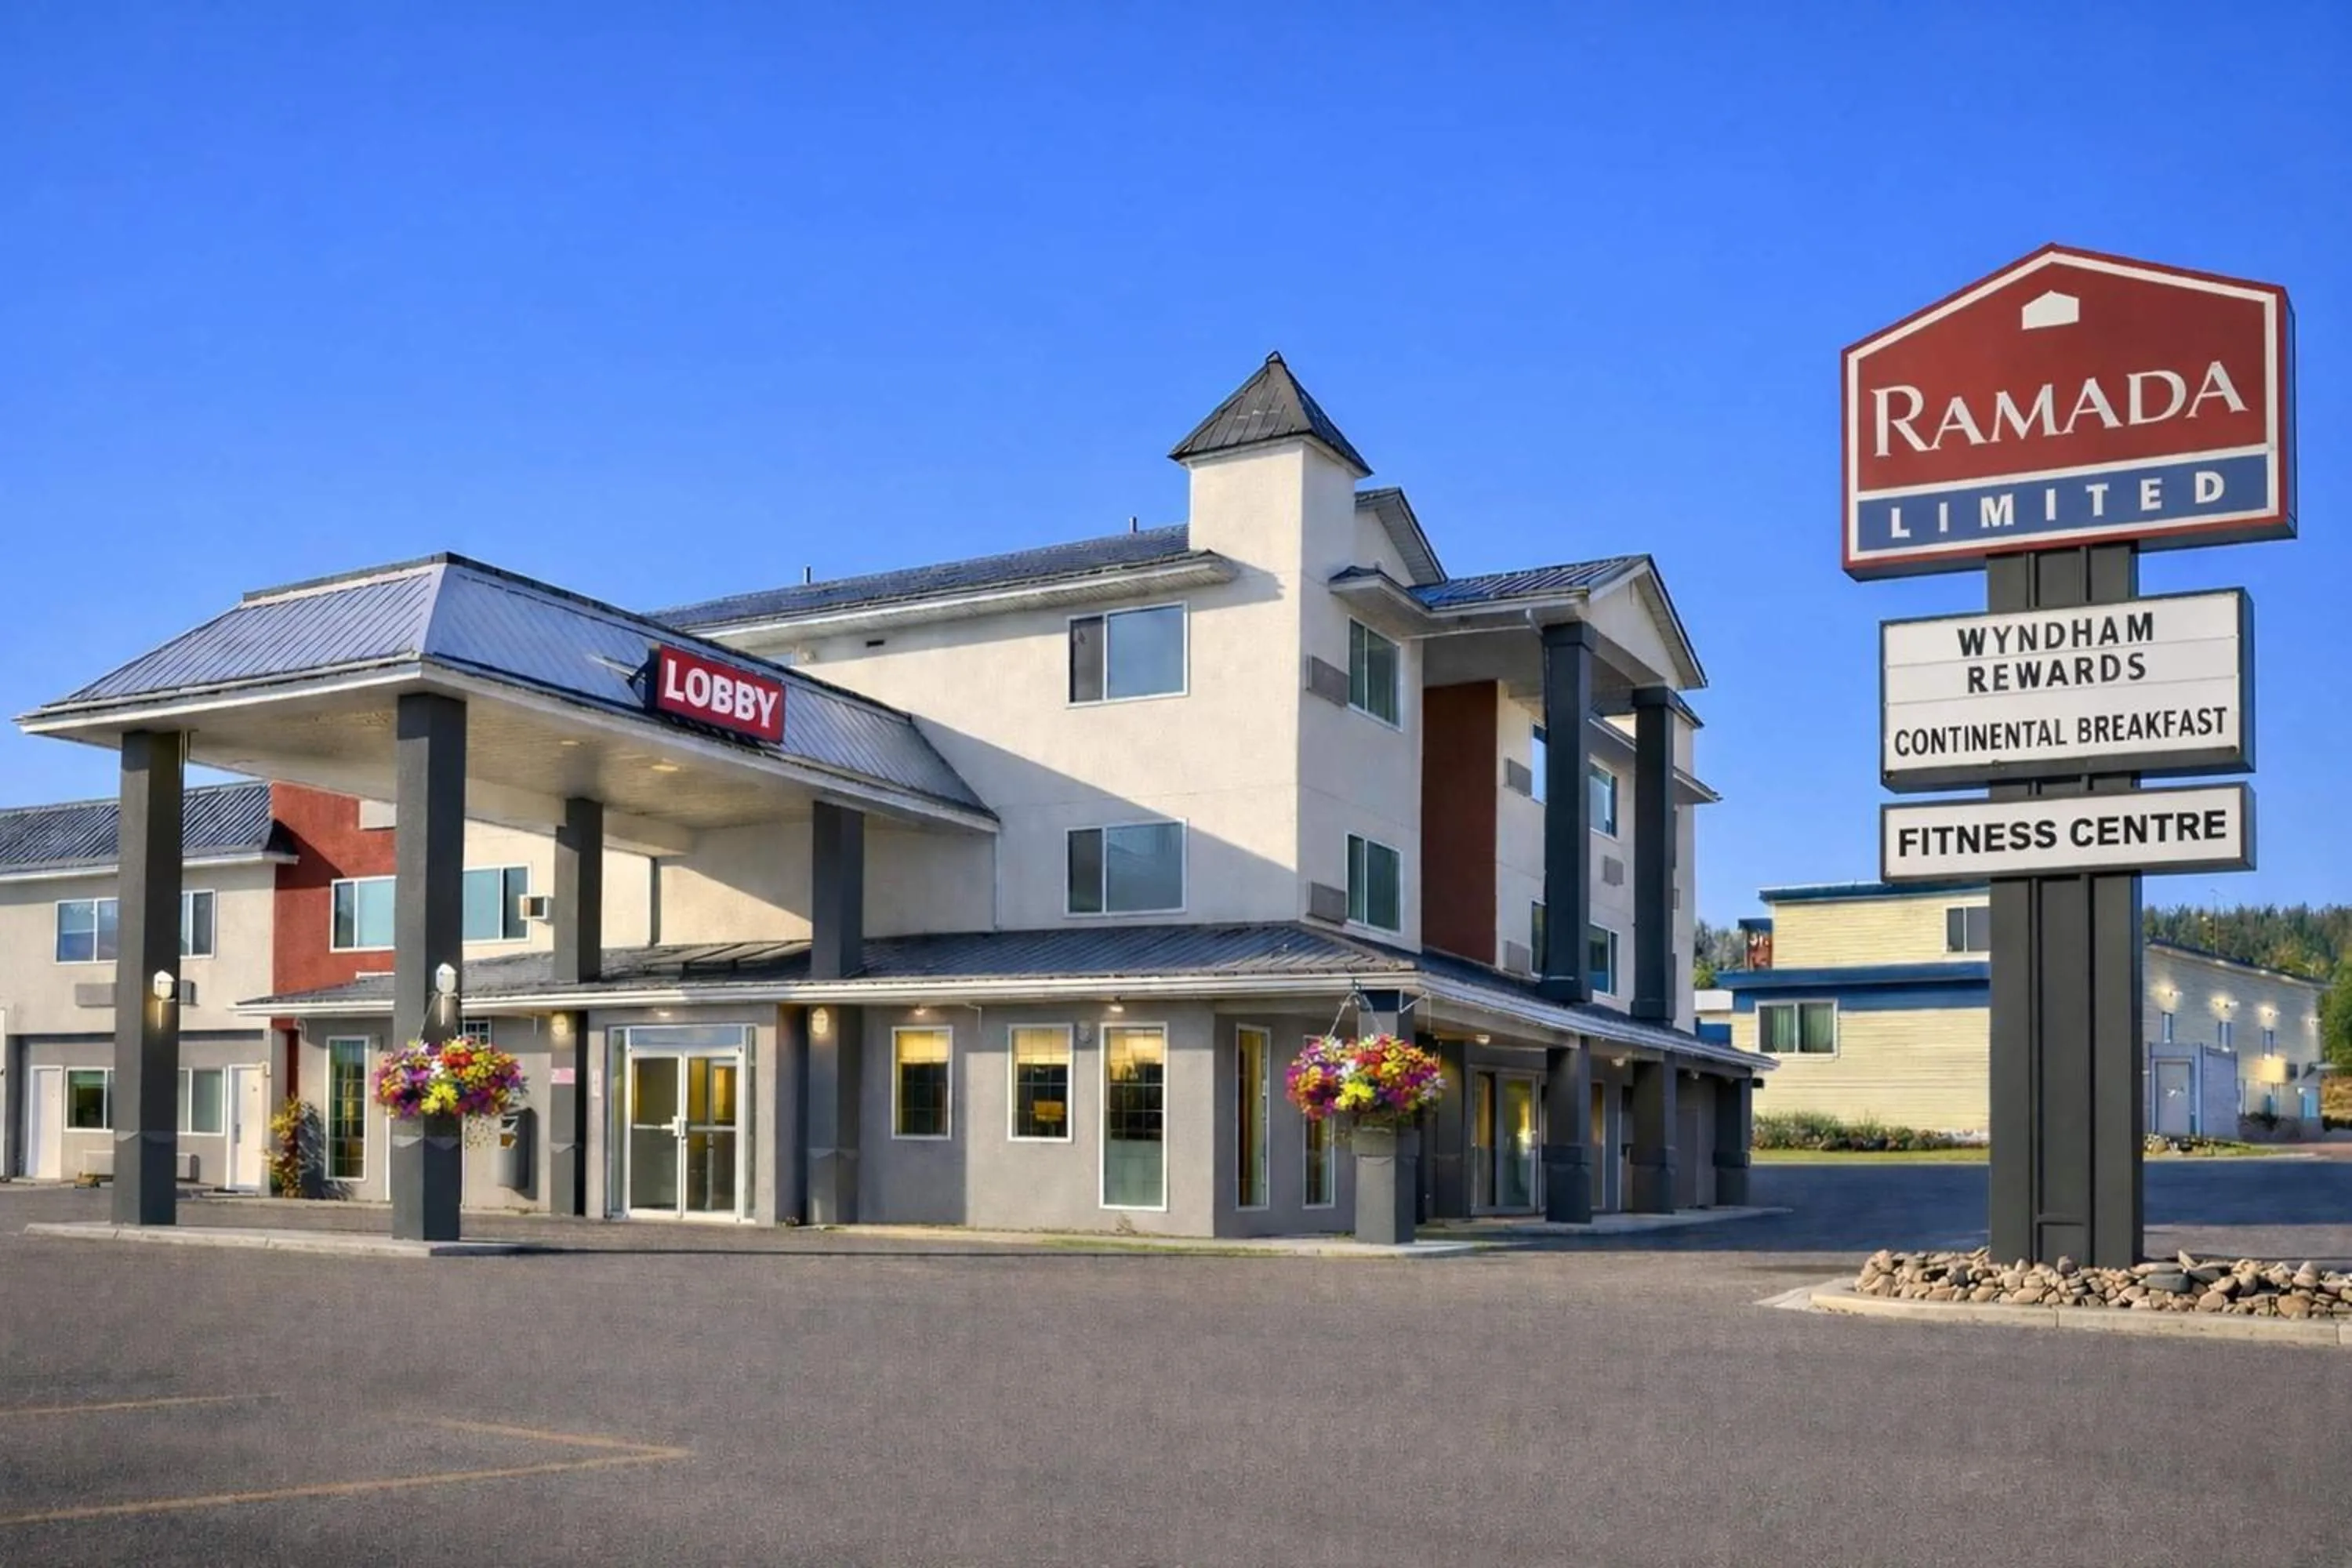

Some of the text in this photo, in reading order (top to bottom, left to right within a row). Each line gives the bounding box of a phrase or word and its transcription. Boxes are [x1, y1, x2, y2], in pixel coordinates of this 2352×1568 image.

[1871, 361, 2249, 456] RAMADA
[1891, 471, 2225, 538] LIMITED
[1958, 612, 2154, 656] WYNDHAM
[665, 659, 779, 728] LOBBY
[1968, 652, 2147, 694] REWARDS
[1895, 707, 2227, 756] CONTINENTAL BREAKFAST
[1898, 810, 2227, 857] FITNESS CENTRE
